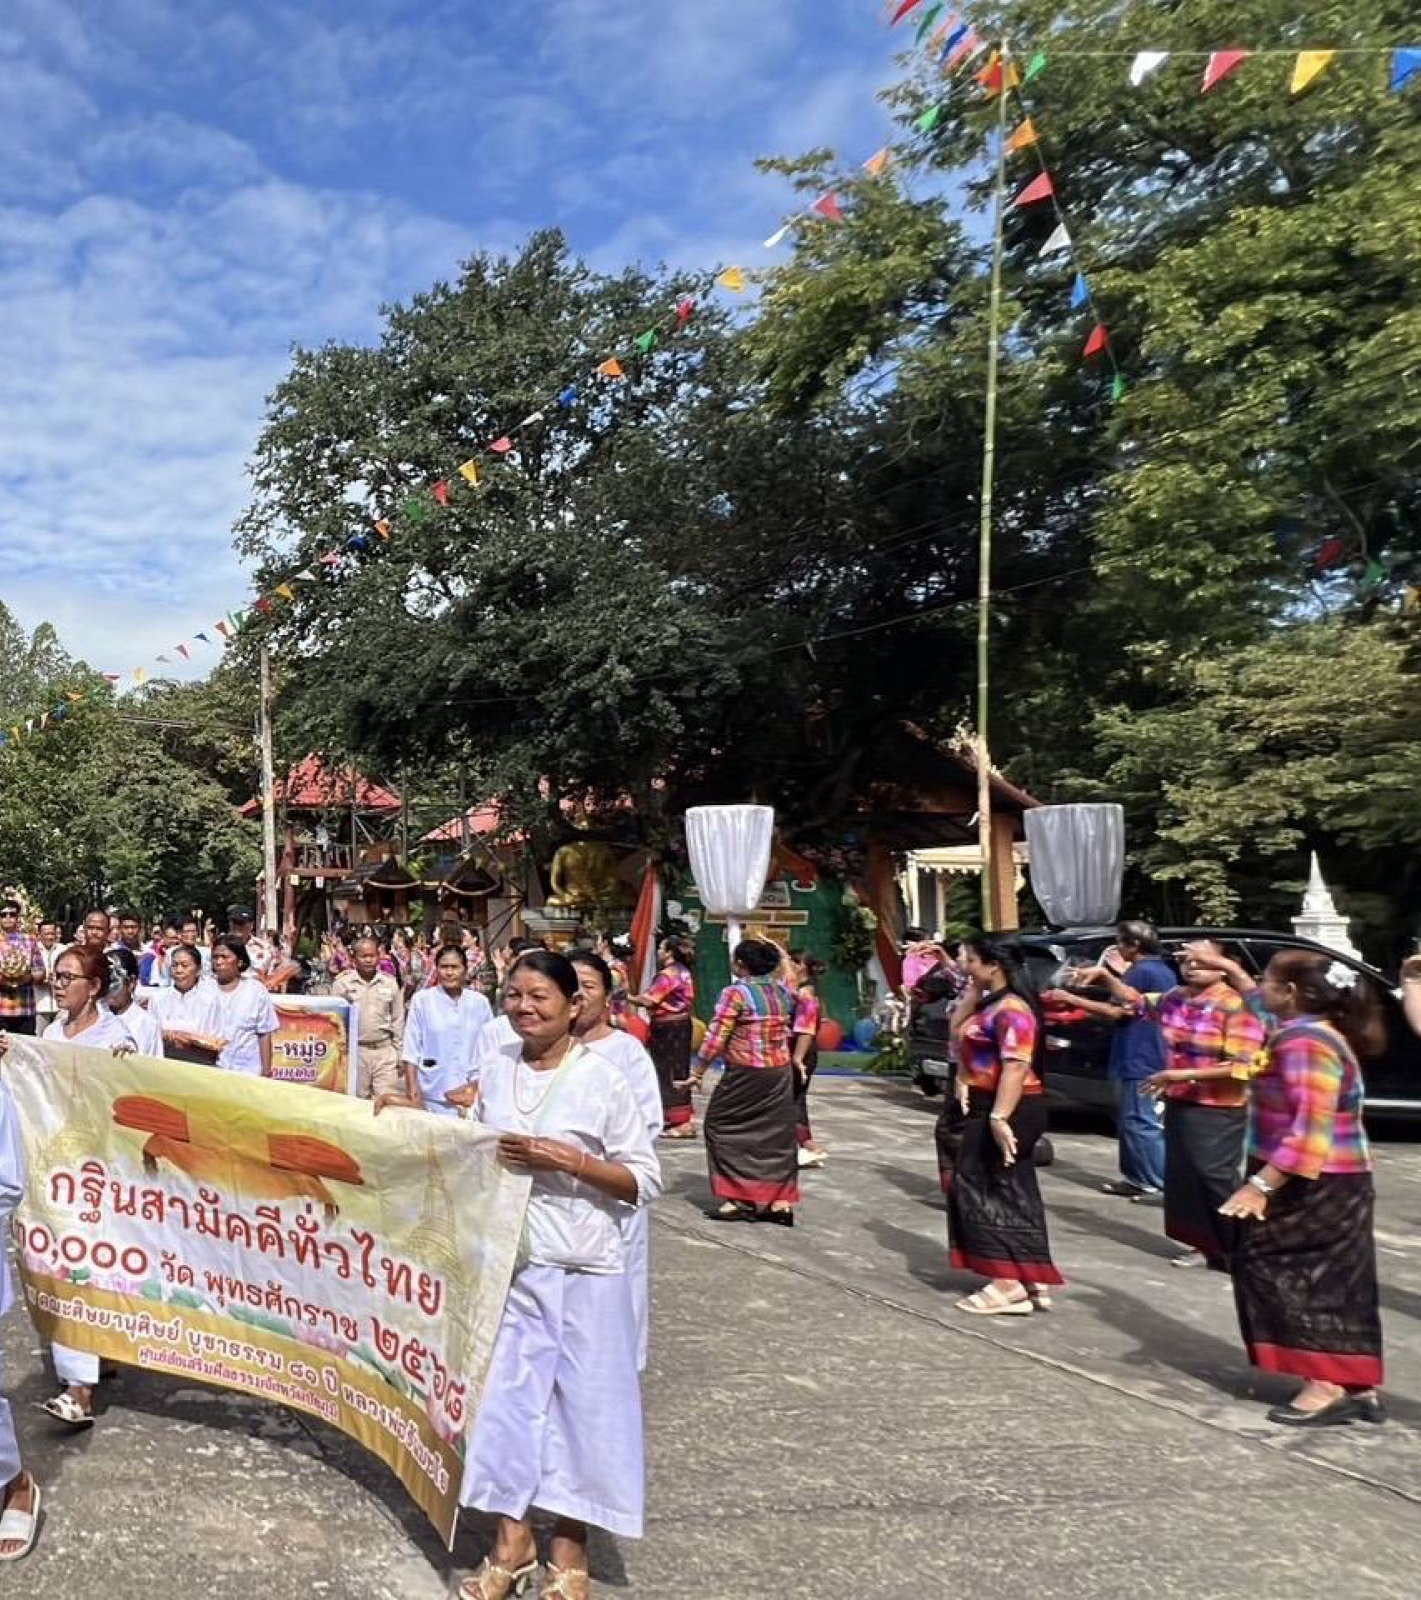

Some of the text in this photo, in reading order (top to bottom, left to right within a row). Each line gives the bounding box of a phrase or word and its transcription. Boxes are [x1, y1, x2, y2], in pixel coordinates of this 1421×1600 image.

[50, 1160, 442, 1316] กฐินสามัคคีทั่วไทย
[161, 1250, 195, 1287] วัด
[203, 1269, 359, 1342] พุทธศักราช
[370, 1316, 466, 1421] ๒๕๖๘
[187, 1330, 283, 1371] บูชาธรรม
[323, 1367, 339, 1396] ปี
